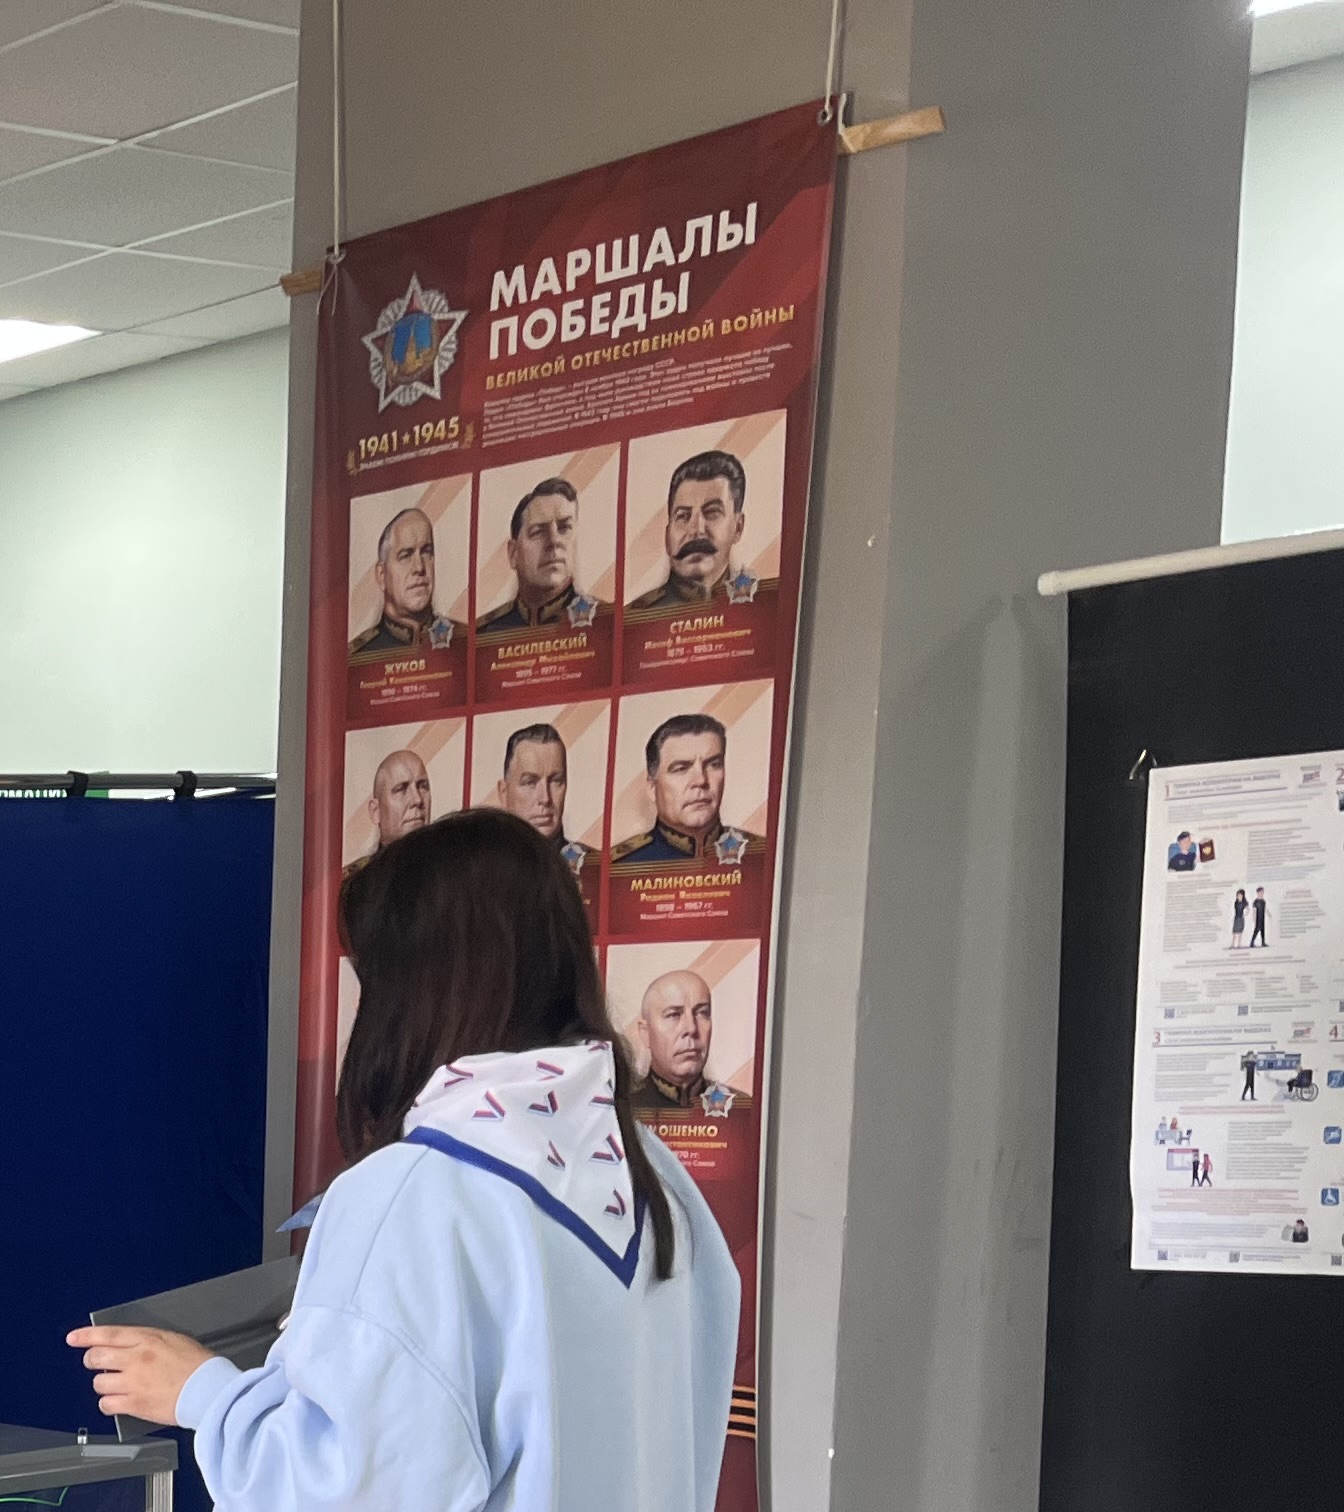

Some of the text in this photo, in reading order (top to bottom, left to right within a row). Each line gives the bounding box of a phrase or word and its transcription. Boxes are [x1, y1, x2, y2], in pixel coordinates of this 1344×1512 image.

[489, 202, 759, 312] МАРШАЛЫ
[488, 271, 692, 360] ПОБЕДЫ
[485, 303, 796, 390] ВЕЛИКОЙ ОТЕЧЕСТВЕННОЙ ВОЙНЫ
[359, 429, 398, 459] 1941
[413, 415, 460, 446] 1945
[669, 615, 724, 634] СТАЛИН
[497, 633, 587, 659] ВАСИЛЕВСКИЙ
[384, 659, 426, 675] ЖУКОВ
[629, 869, 742, 892] МАЛИНОВСКИЙ
[1153, 1031, 1161, 1045] 3
[1328, 1024, 1339, 1039] 4
